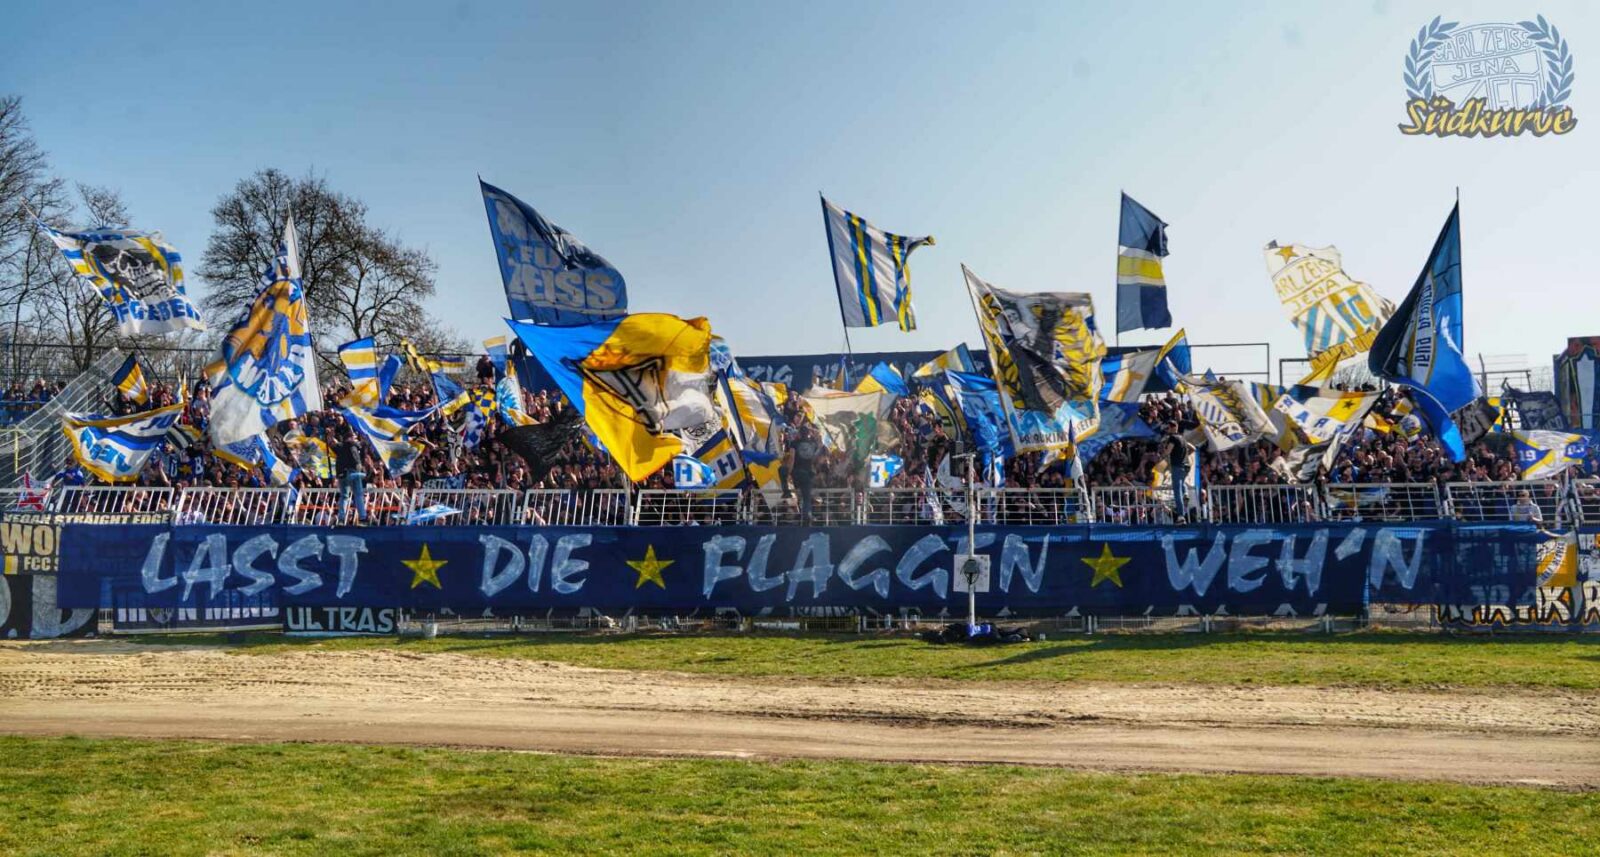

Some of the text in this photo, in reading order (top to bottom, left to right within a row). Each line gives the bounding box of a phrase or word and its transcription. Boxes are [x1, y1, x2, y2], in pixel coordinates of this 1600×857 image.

[507, 257, 617, 309] ZEISS
[54, 514, 131, 525] STRAIGHT
[136, 514, 170, 524] EDGE
[1, 523, 61, 557] WO
[24, 556, 50, 571] FCC
[141, 532, 369, 602] LASST
[479, 533, 593, 598] DIE
[287, 606, 394, 633] ULTRAS
